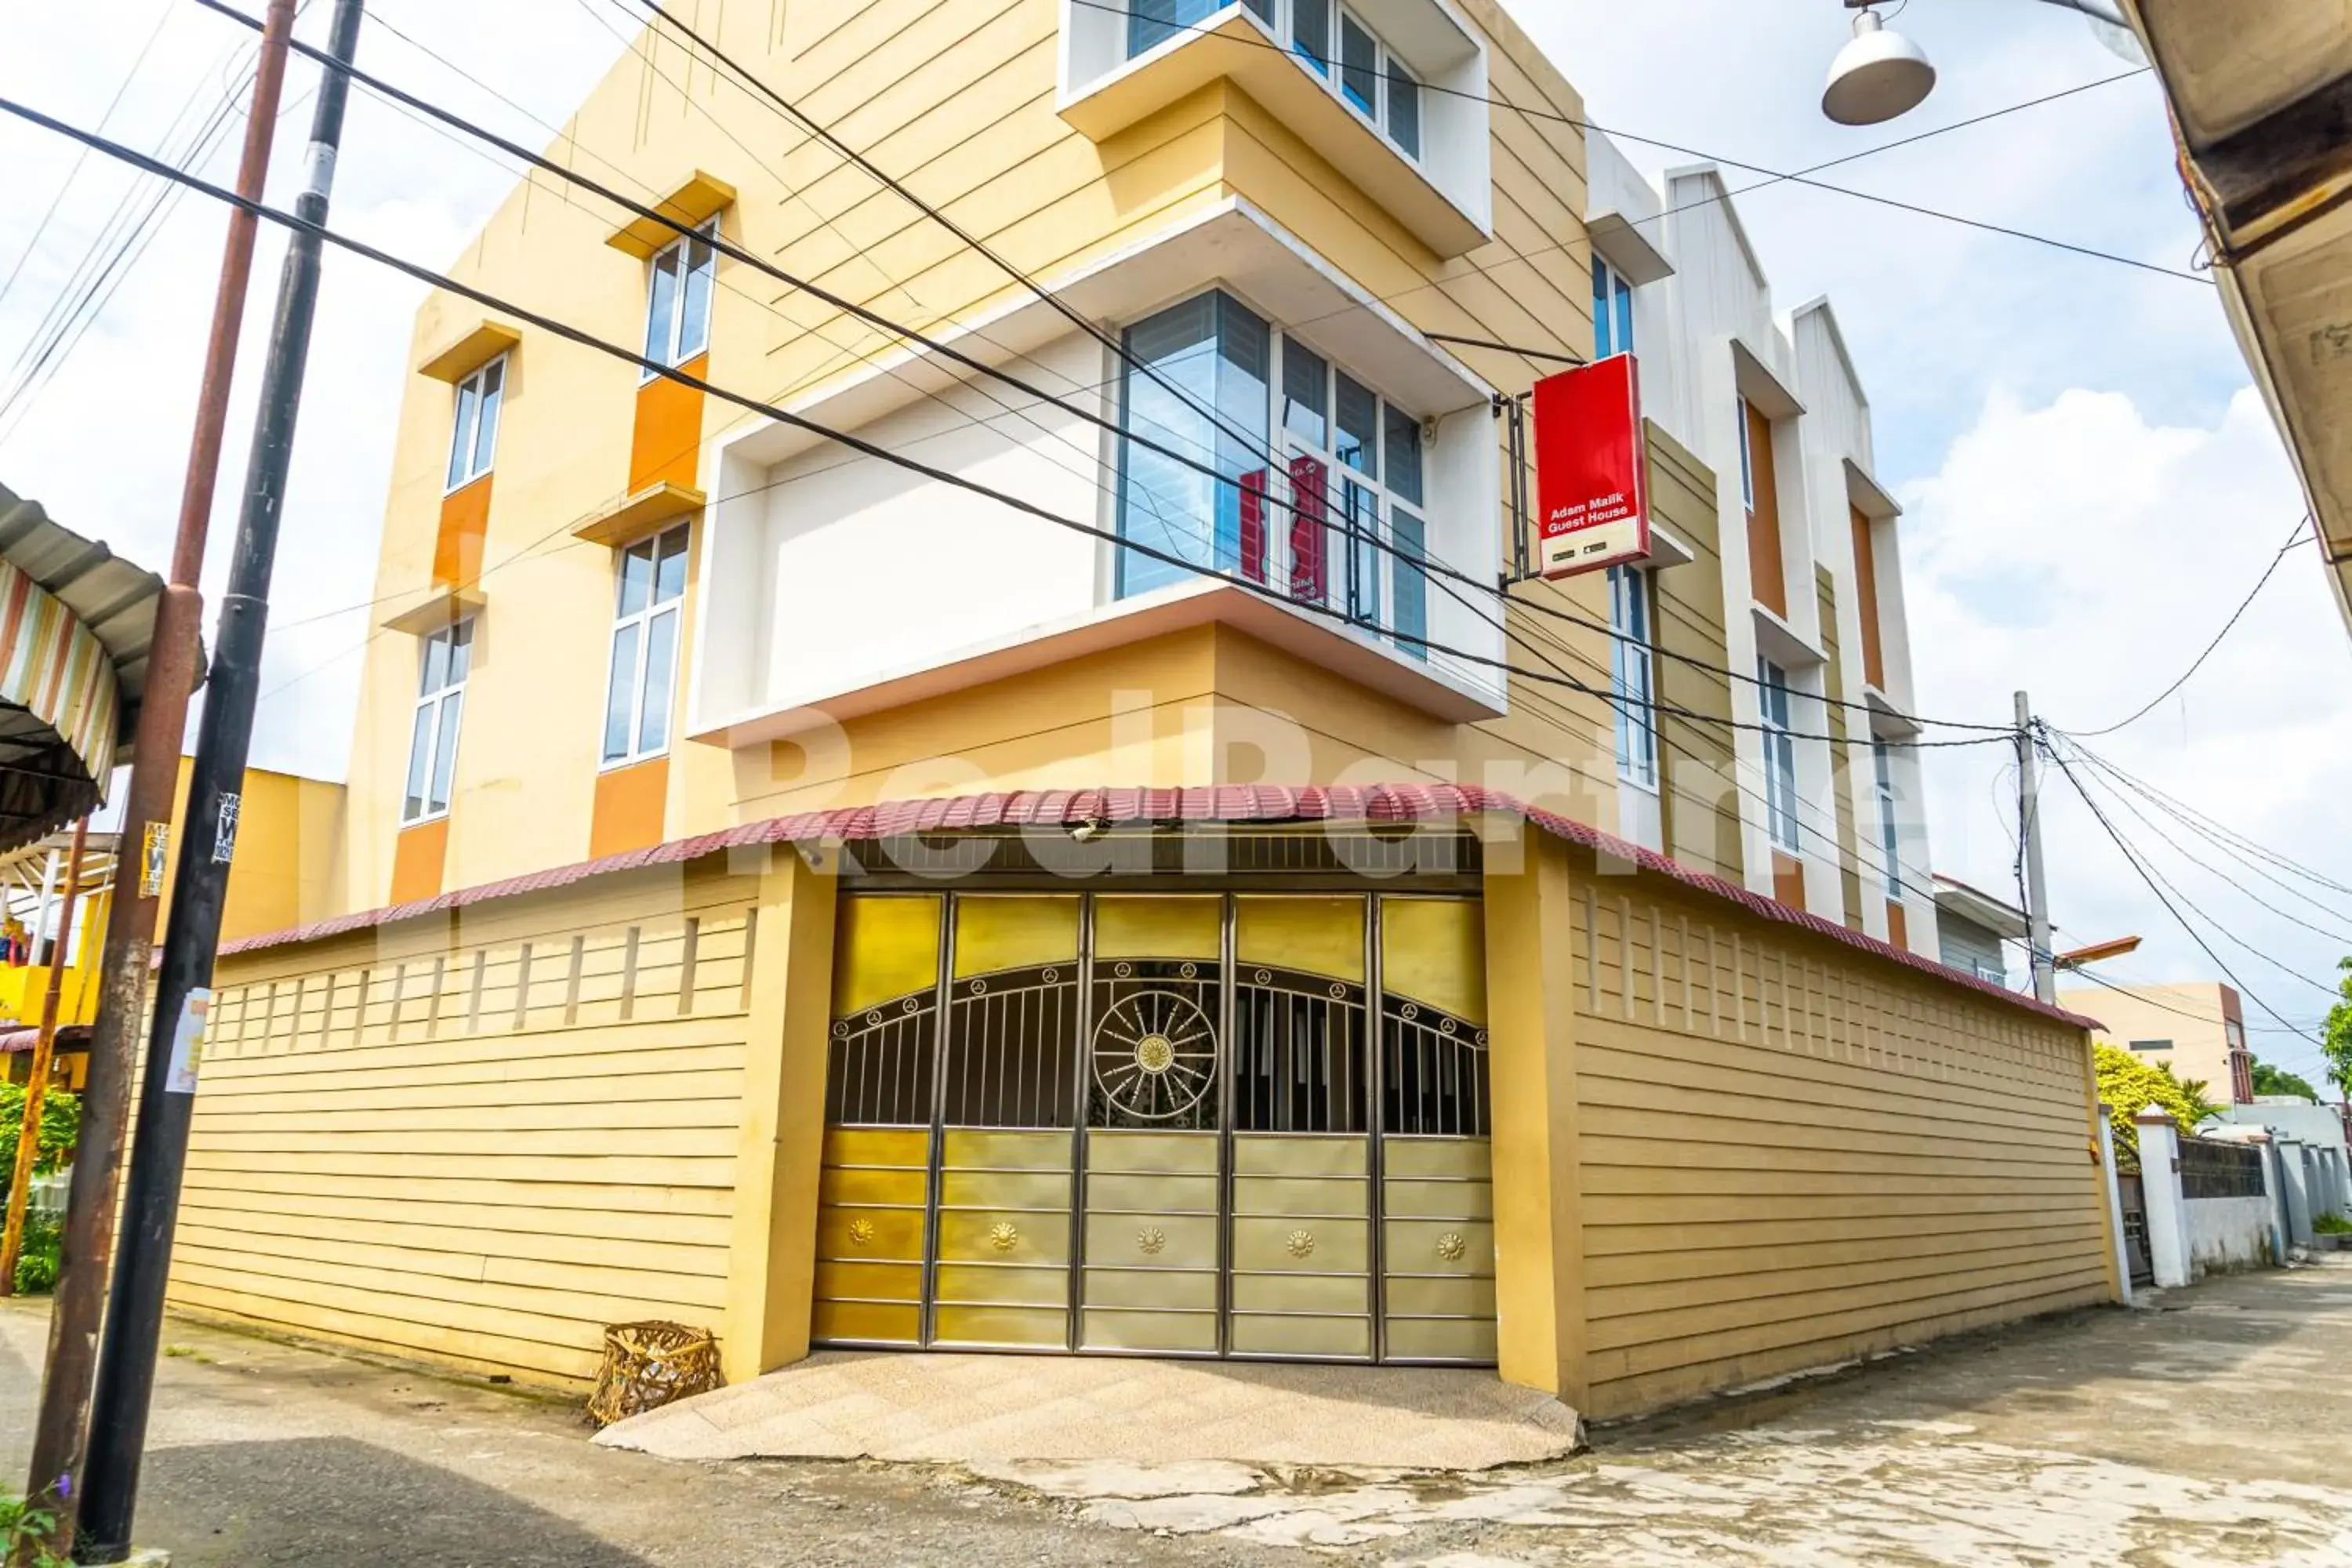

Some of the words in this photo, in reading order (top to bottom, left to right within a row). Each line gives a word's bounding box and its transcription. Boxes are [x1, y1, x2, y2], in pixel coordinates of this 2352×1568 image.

[1549, 517, 1584, 532] Guest
[1588, 506, 1628, 523] House
[1552, 505, 1585, 520] Adam
[1588, 492, 1624, 510] Malik
